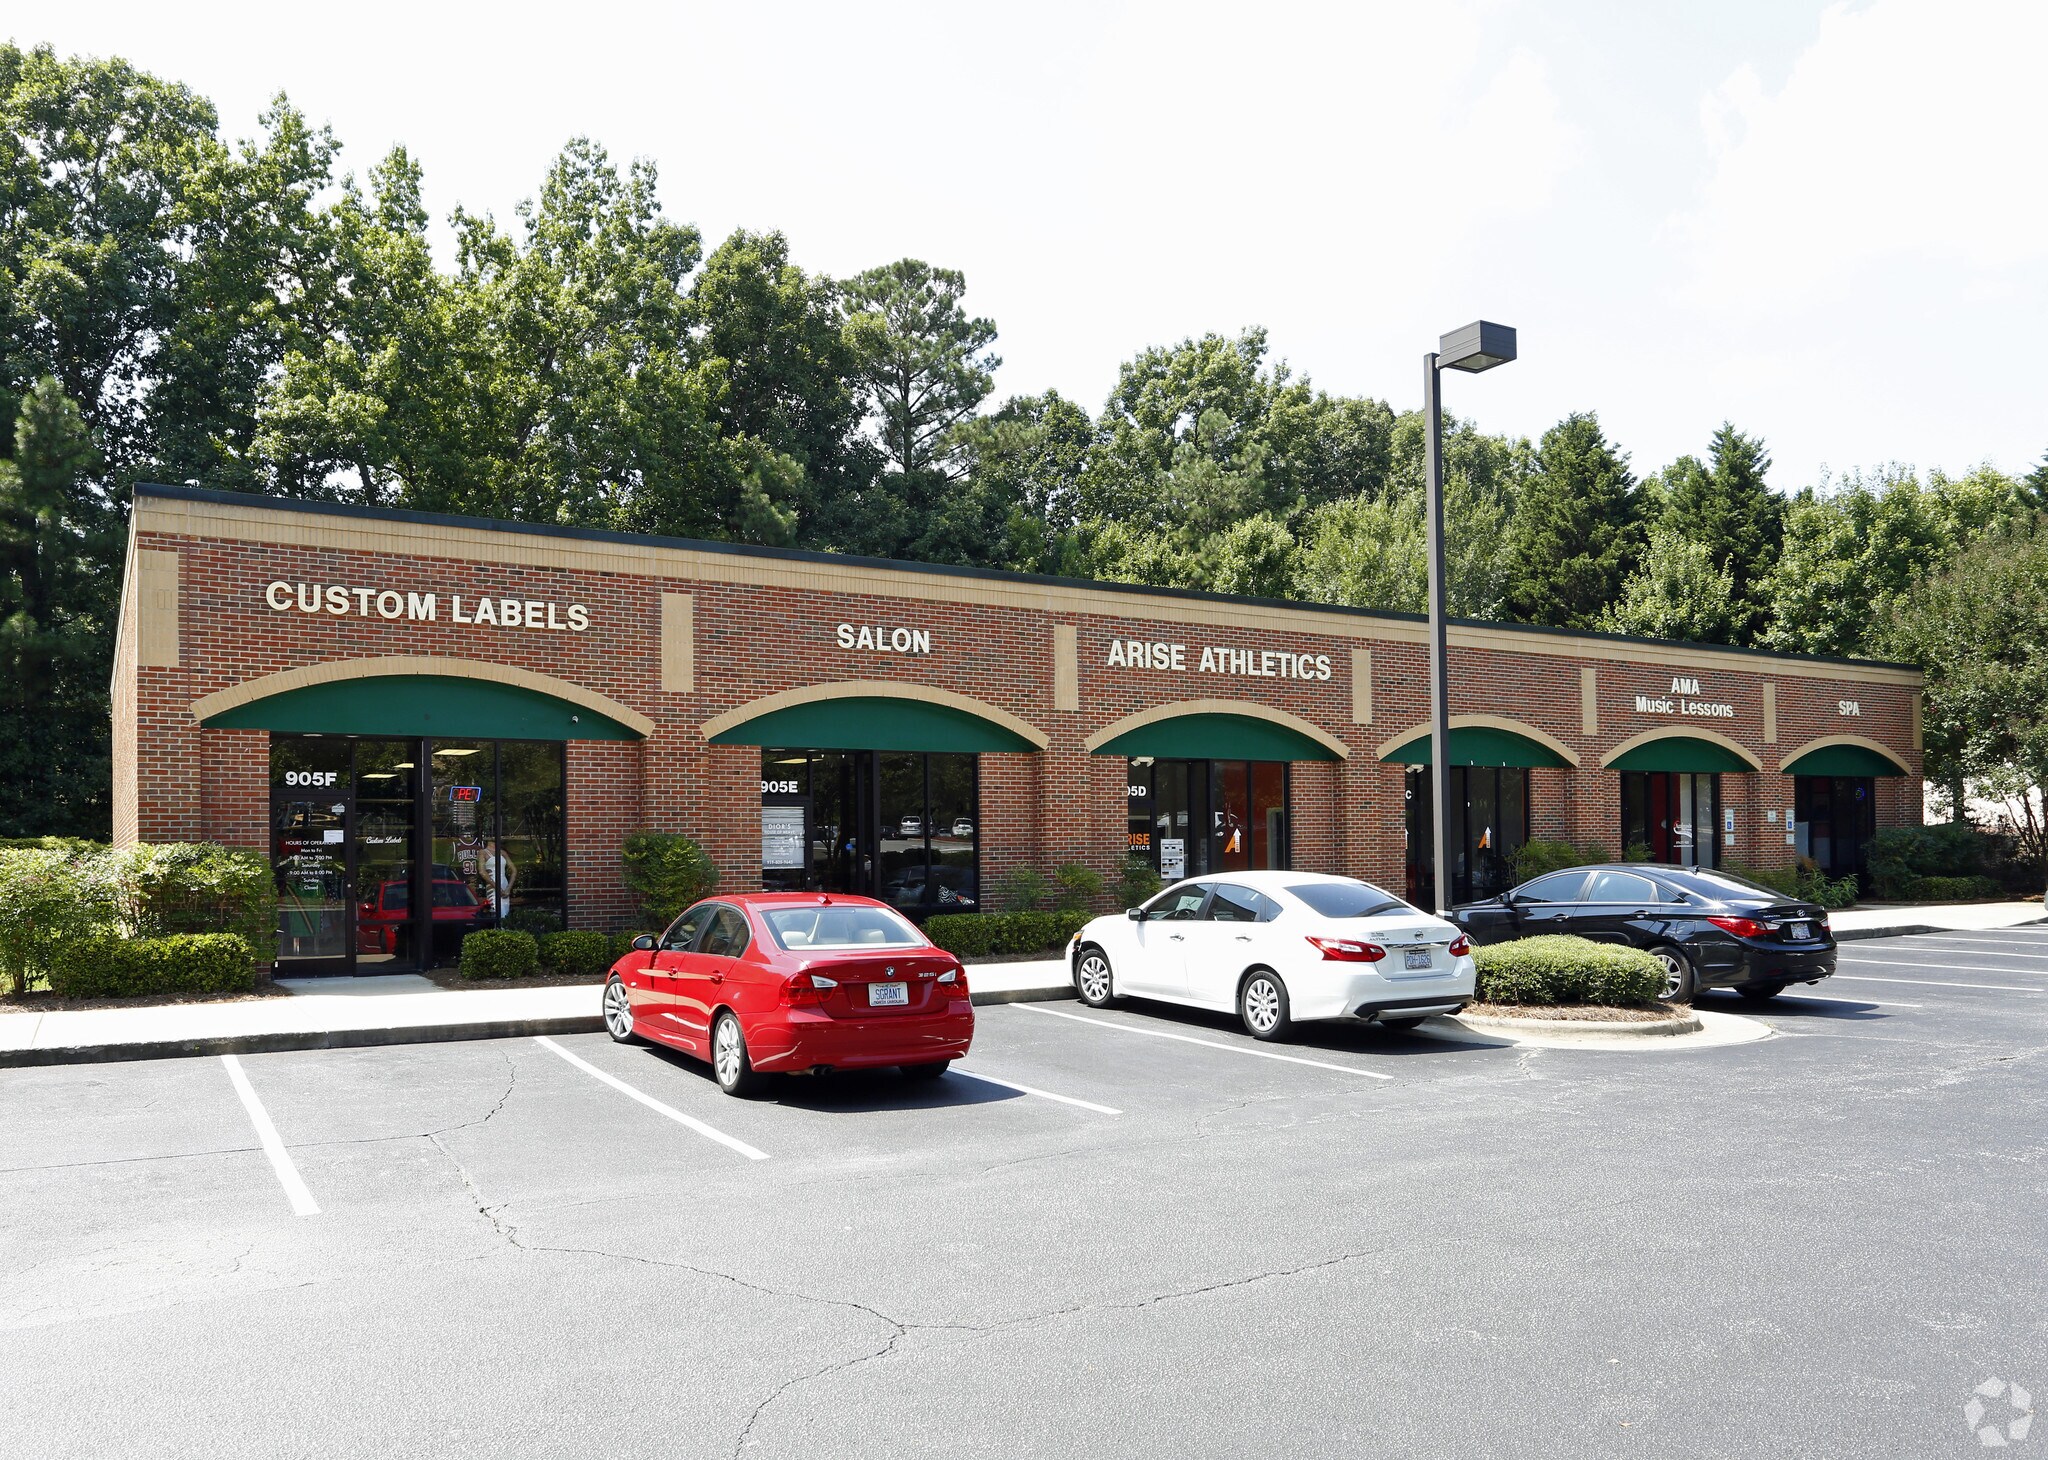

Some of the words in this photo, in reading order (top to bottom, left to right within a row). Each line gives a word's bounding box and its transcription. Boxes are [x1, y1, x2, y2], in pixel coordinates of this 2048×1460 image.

[265, 581, 436, 621] CUSTOM
[452, 595, 589, 631] LABELS
[837, 623, 930, 654] SALON
[1108, 639, 1186, 671] ARISE
[1199, 646, 1332, 681] ATHLETICS
[1671, 678, 1700, 695] AMA
[1635, 696, 1674, 714] Music
[1681, 698, 1734, 718] Lessons
[1838, 700, 1860, 716] SPA
[285, 771, 338, 787] 905F
[761, 780, 798, 794] 905E
[452, 788, 478, 799] OPEN
[463, 861, 477, 874] 91
[875, 988, 901, 999] SGRANT
